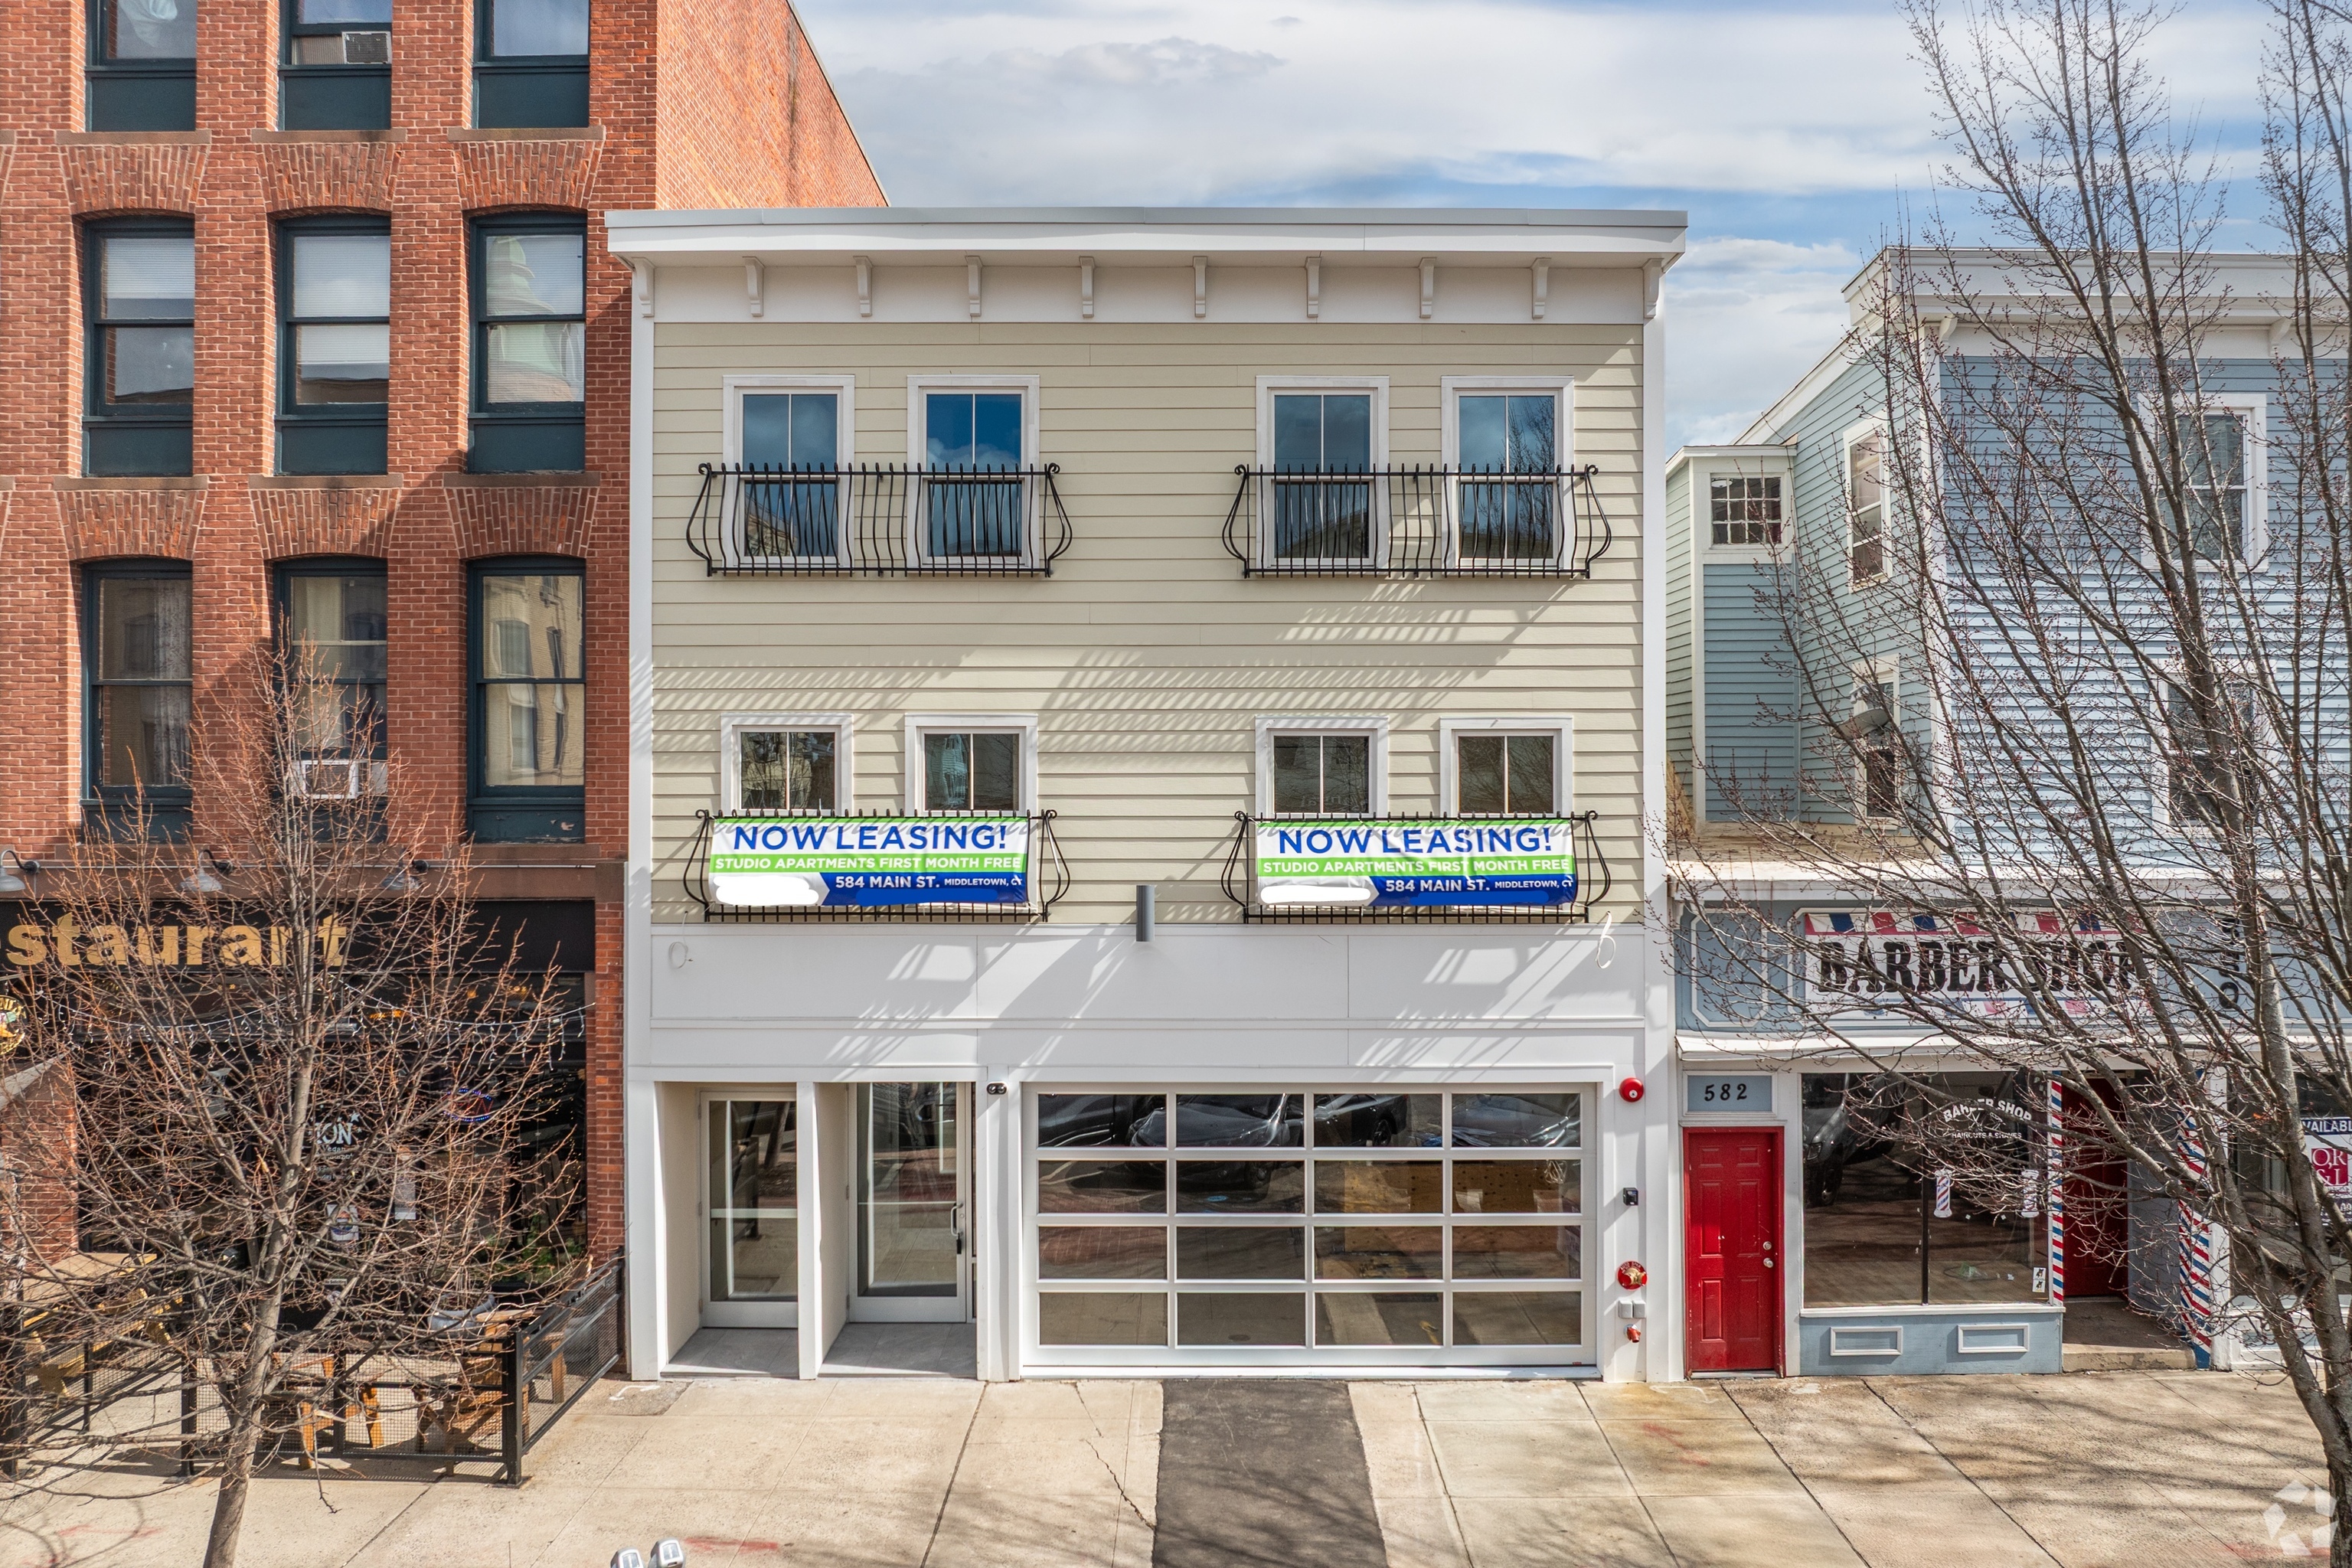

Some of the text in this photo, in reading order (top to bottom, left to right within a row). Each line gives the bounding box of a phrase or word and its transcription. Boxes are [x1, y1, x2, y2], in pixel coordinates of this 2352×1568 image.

[734, 825, 1007, 850] NOW LEASING!
[1279, 828, 1552, 854] NOW LEASING!
[715, 857, 1021, 869] STUDIO APARTMENTS FIRST MONTH FREE
[1263, 858, 1570, 873] STUDIO APARTMENTS FIRST MONTH FREE
[835, 875, 1023, 888] 584 MAIN ST. MIDDLETOWN, CT
[1386, 880, 1416, 892] 584
[1420, 879, 1462, 892] MAIN
[1466, 878, 1490, 891] ST.
[1494, 880, 1560, 889] MIDDLETOWN,
[0, 912, 348, 966] staurant
[1818, 942, 2007, 993] BARBER
[1704, 1083, 1747, 1102] 582
[1998, 1099, 2032, 1121] SHOP
